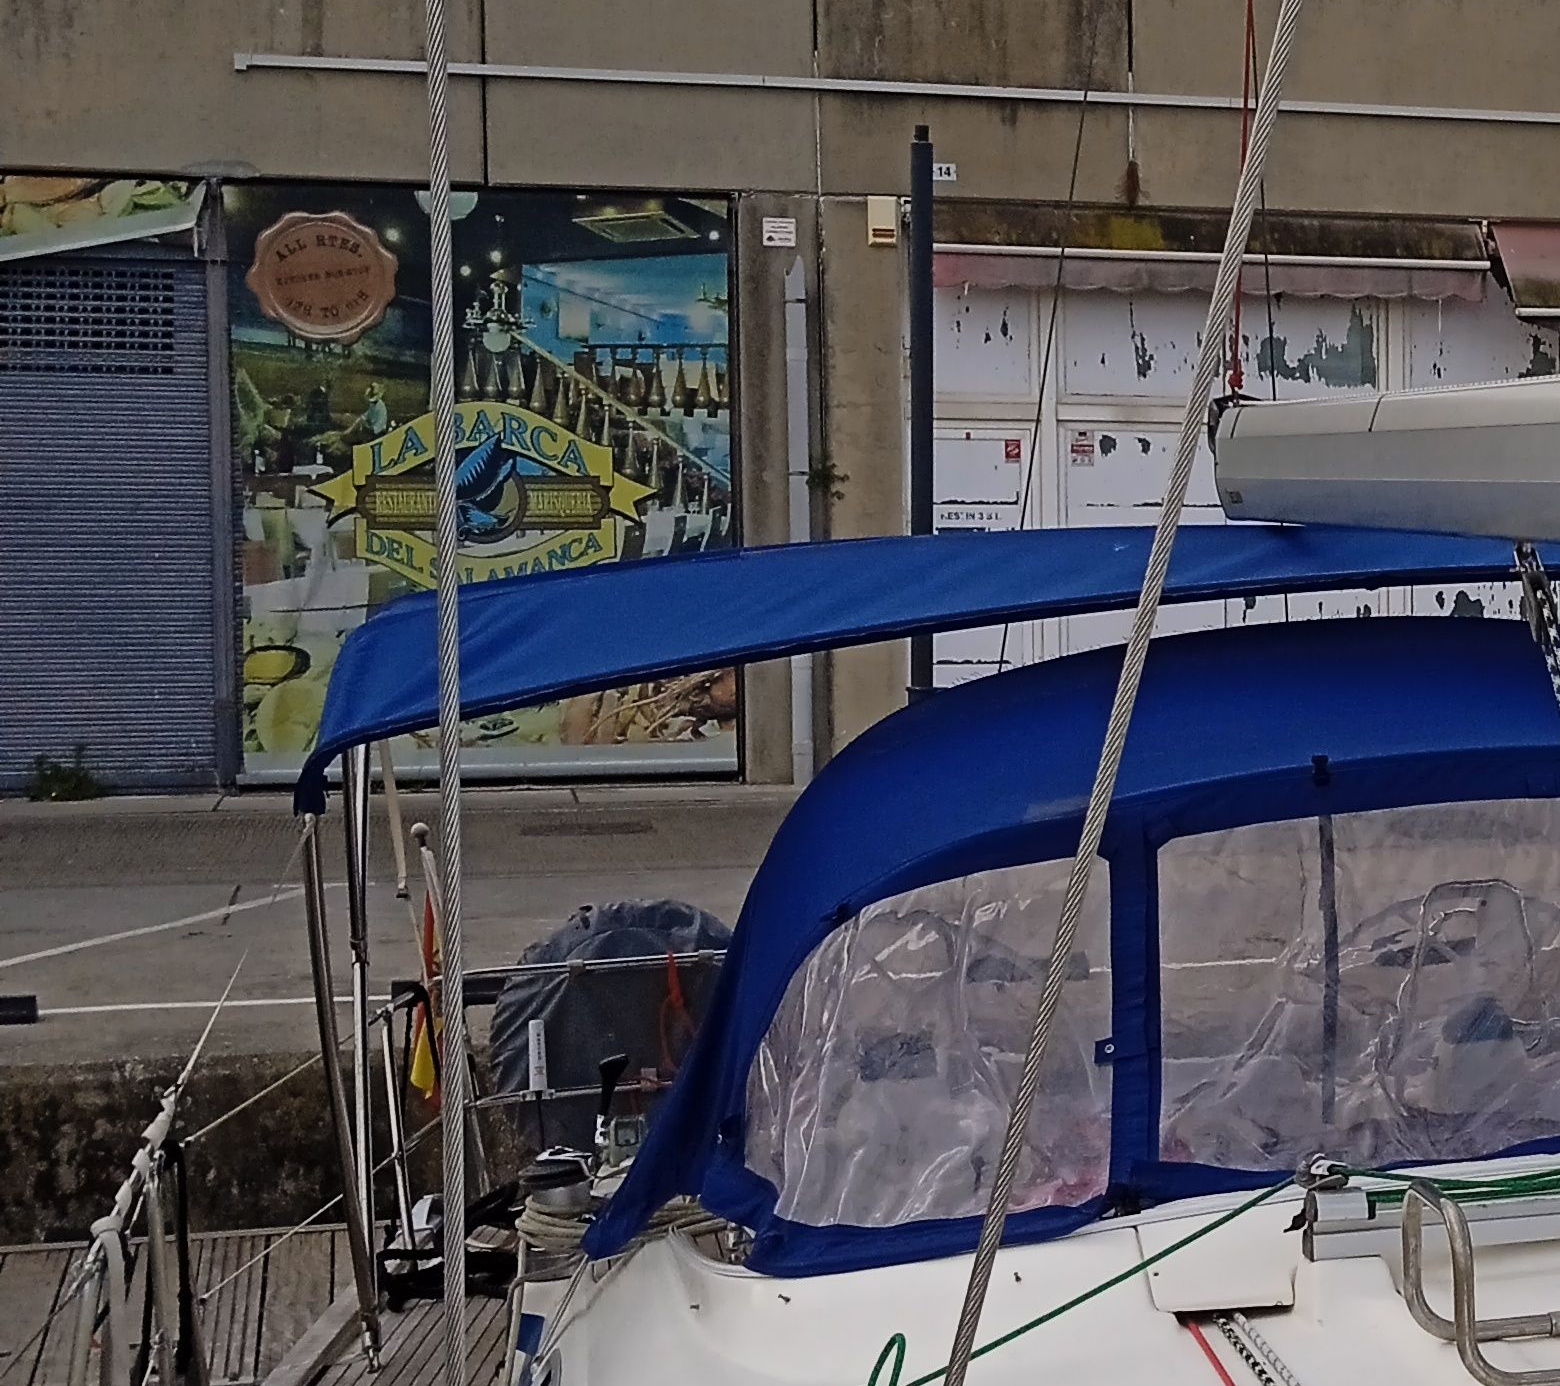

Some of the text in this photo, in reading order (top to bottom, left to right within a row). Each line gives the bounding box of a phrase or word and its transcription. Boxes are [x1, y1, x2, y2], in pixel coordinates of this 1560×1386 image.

[938, 166, 951, 178] 14
[276, 239, 307, 262] ALL
[320, 305, 340, 318] TO
[371, 409, 590, 476] LA BARCA
[365, 531, 424, 572] DEL
